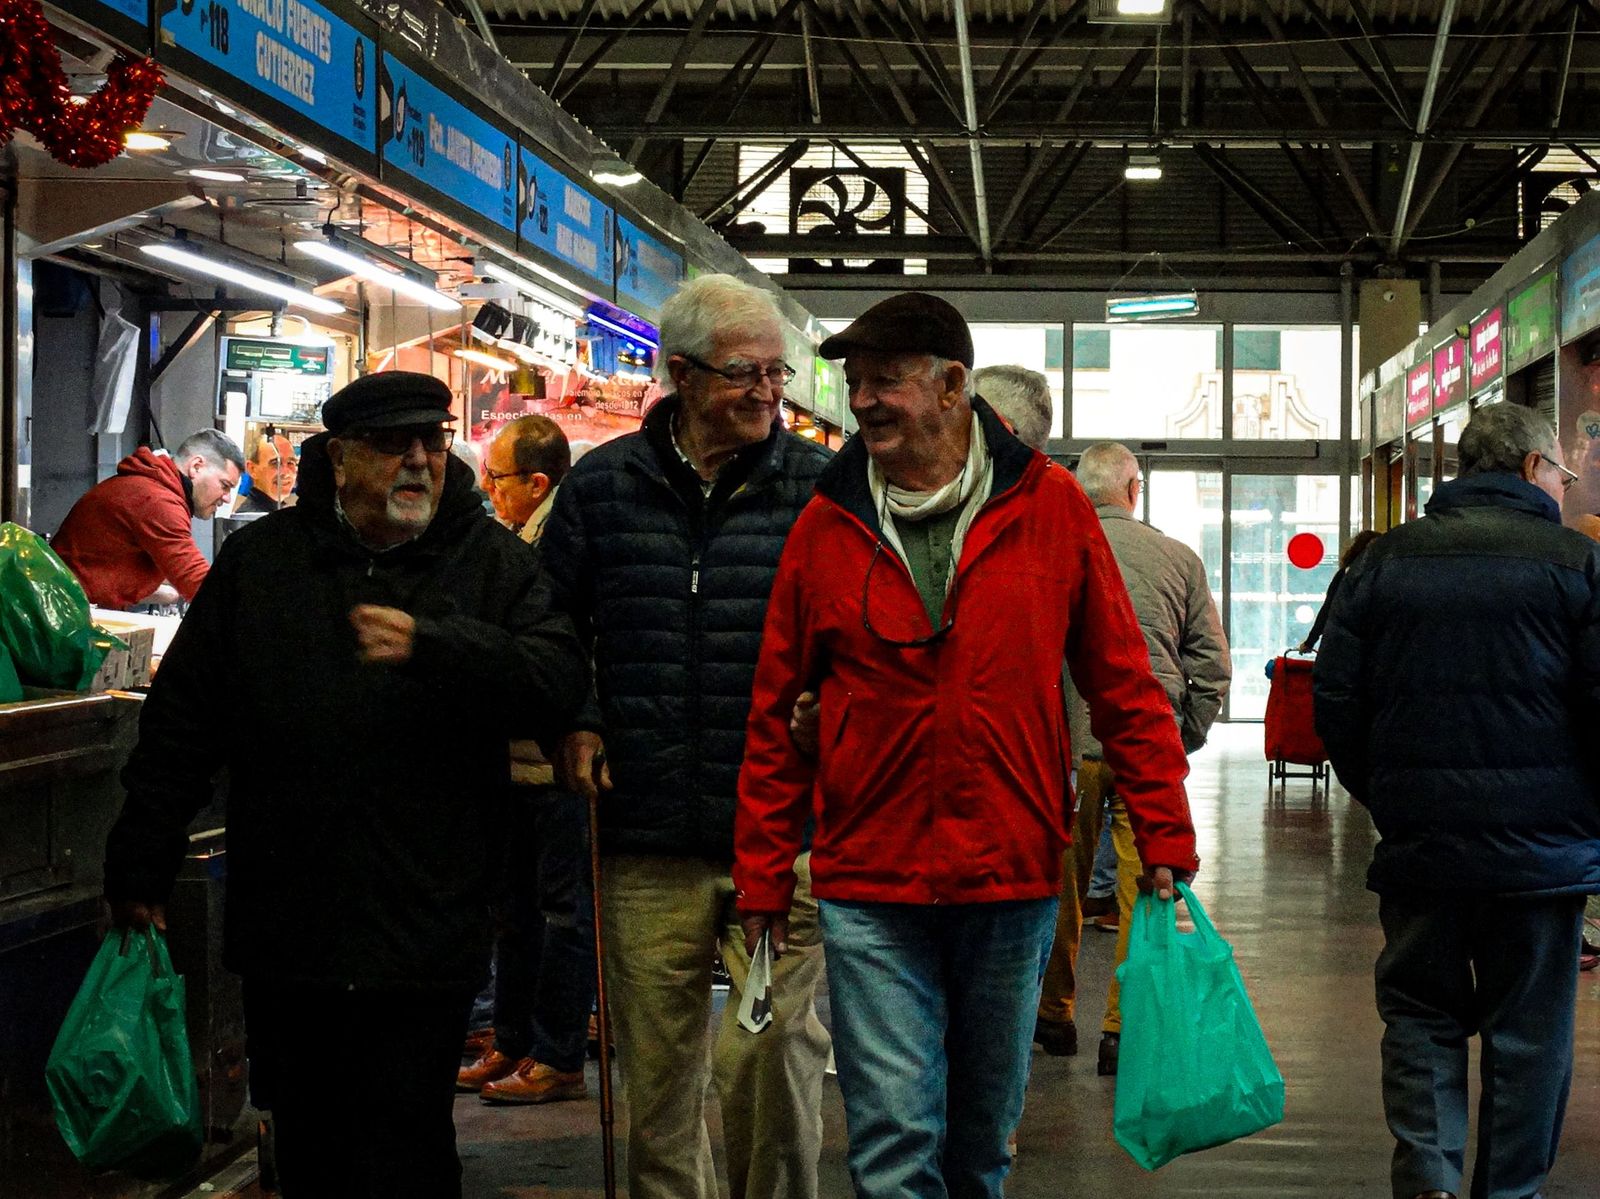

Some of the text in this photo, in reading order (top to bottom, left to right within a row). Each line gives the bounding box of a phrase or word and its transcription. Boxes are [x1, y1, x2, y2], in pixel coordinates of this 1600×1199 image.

[286, 0, 332, 64] FUENTES
[255, 30, 315, 106] GUTIERREZ
[567, 412, 582, 421] en
